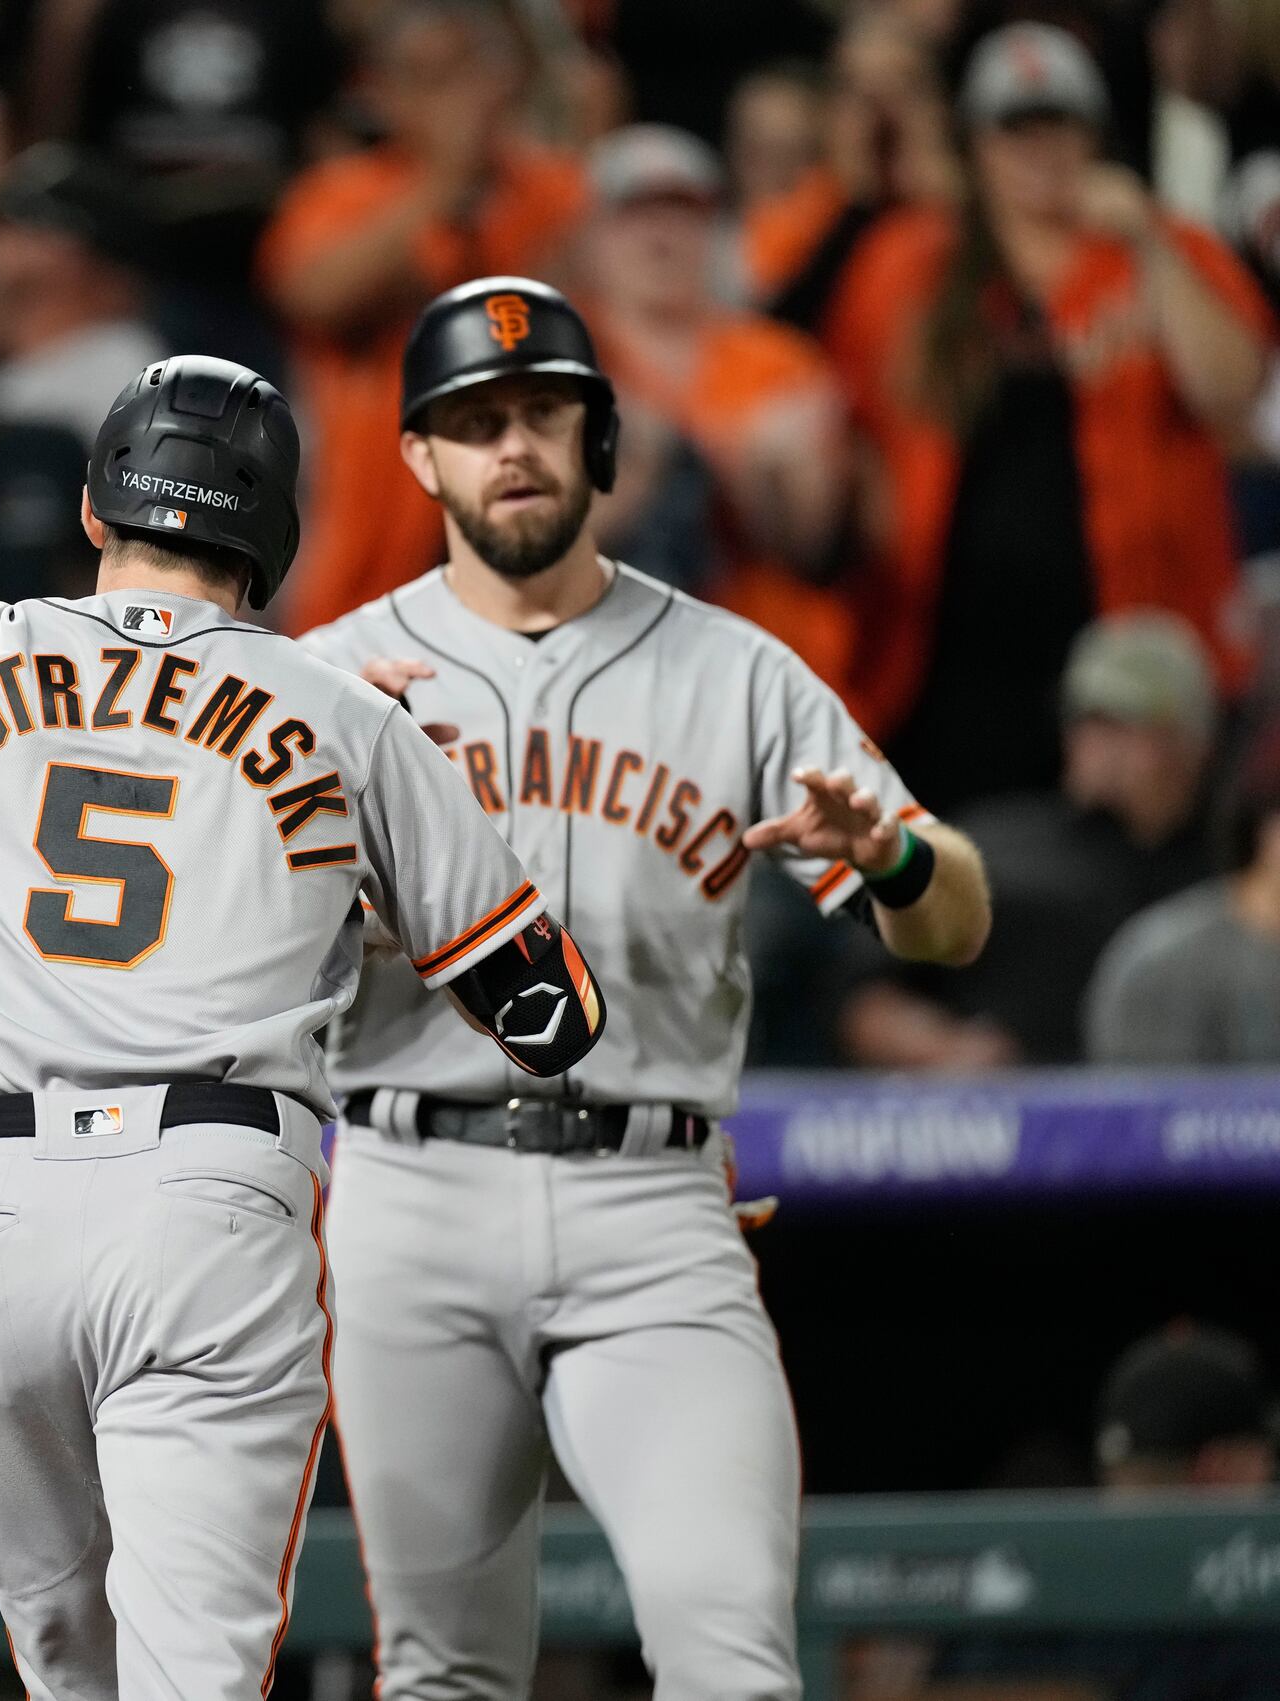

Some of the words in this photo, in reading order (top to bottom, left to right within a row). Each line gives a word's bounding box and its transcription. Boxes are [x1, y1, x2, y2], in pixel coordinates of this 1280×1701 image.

[484, 293, 529, 352] SF
[121, 470, 240, 512] YASTRZEMSKI
[22, 760, 181, 970] 5
[447, 728, 752, 902] RANCISCO
